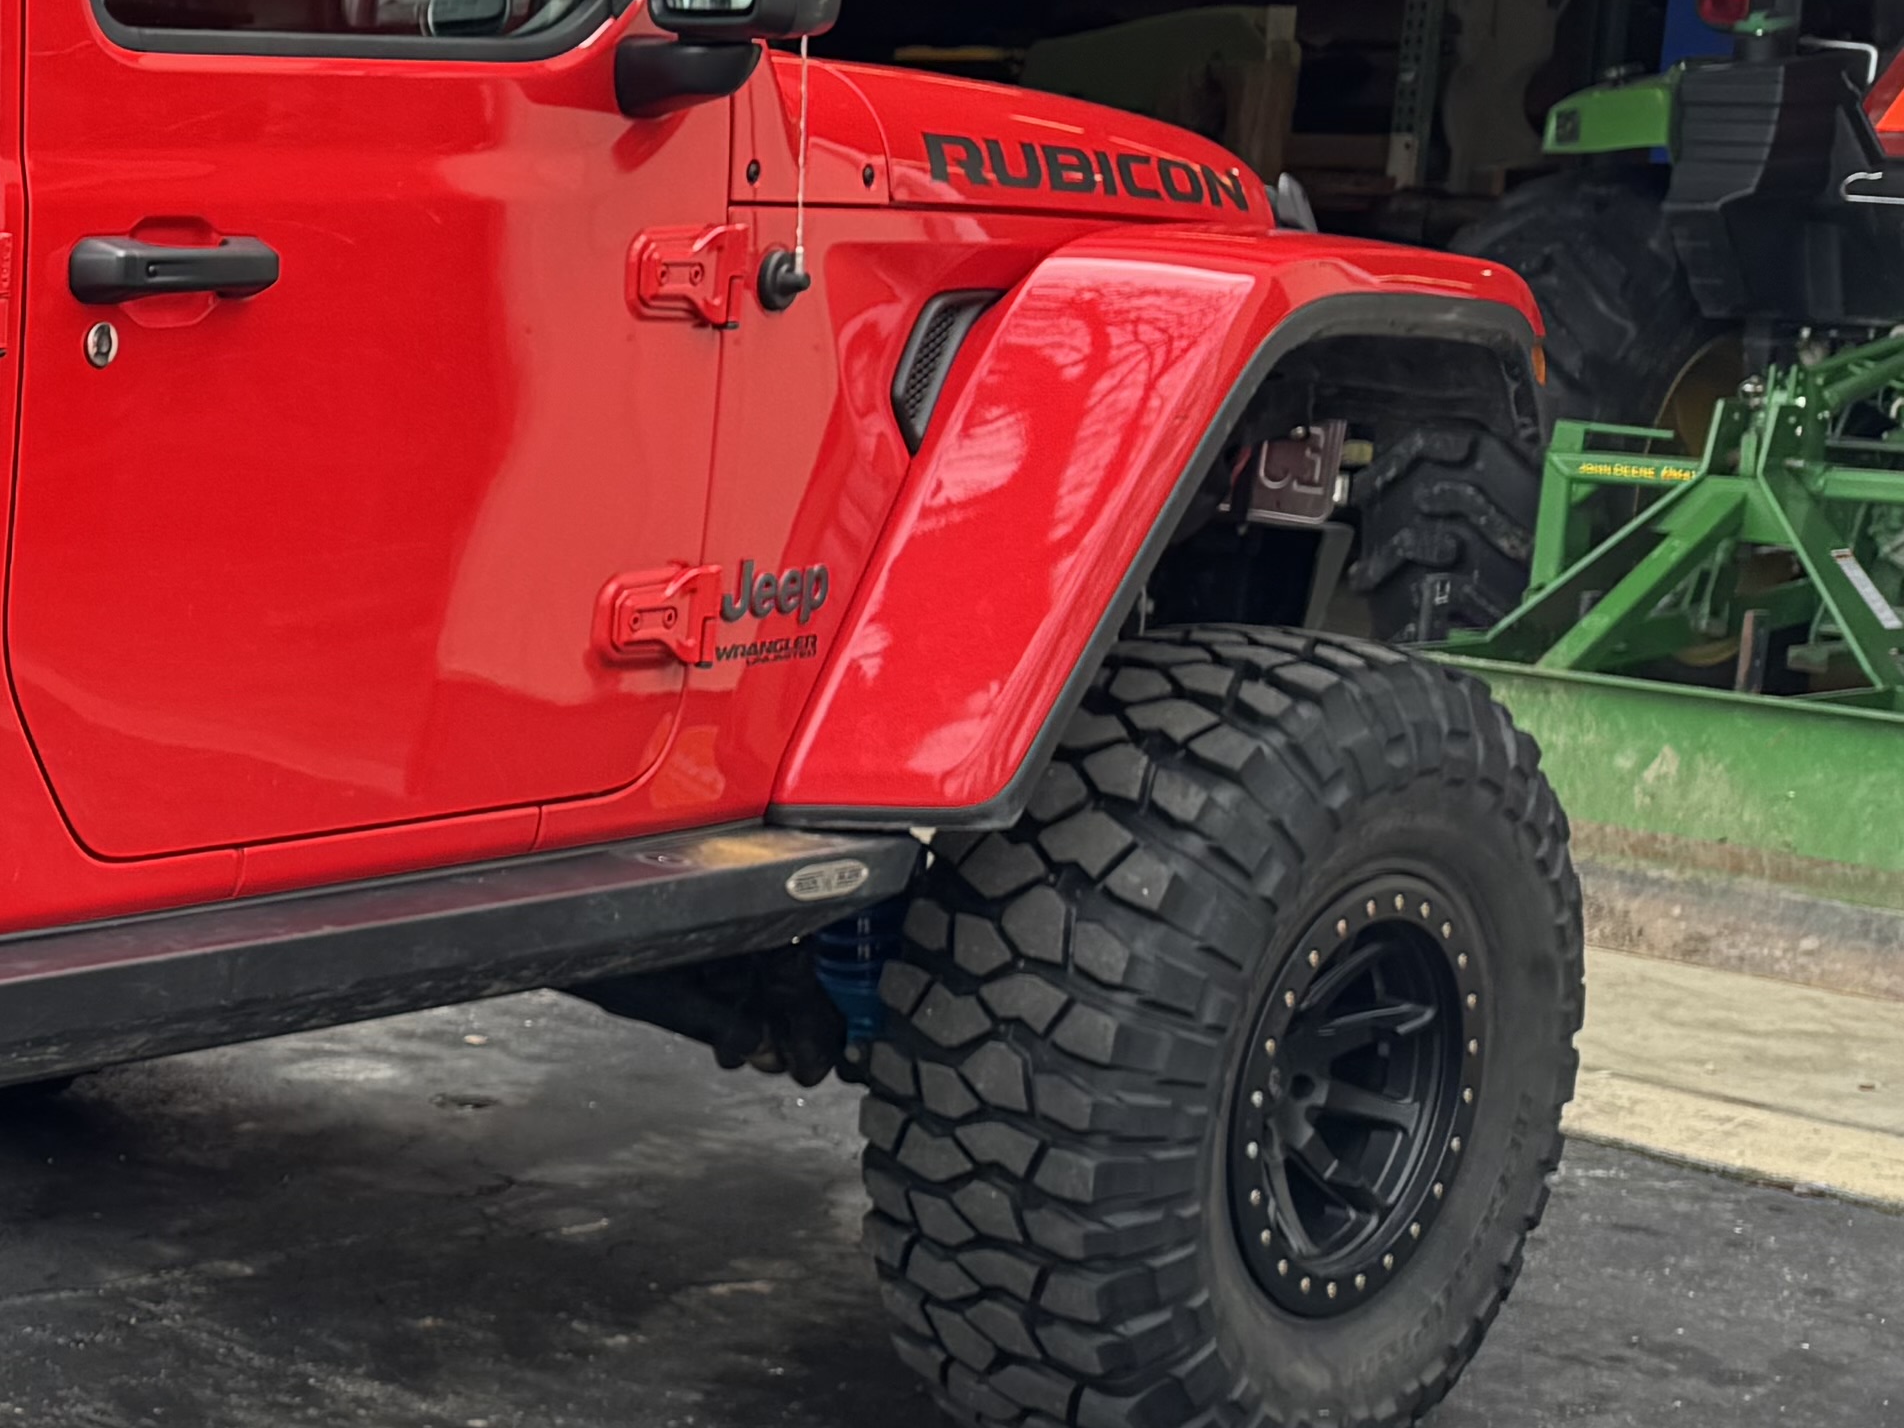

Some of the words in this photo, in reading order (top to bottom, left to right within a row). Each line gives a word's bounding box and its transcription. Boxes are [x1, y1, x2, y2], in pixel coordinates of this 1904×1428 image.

[921, 131, 1249, 212] RUBICON
[720, 559, 829, 625] Jeep
[715, 634, 818, 662] WRANGLER
